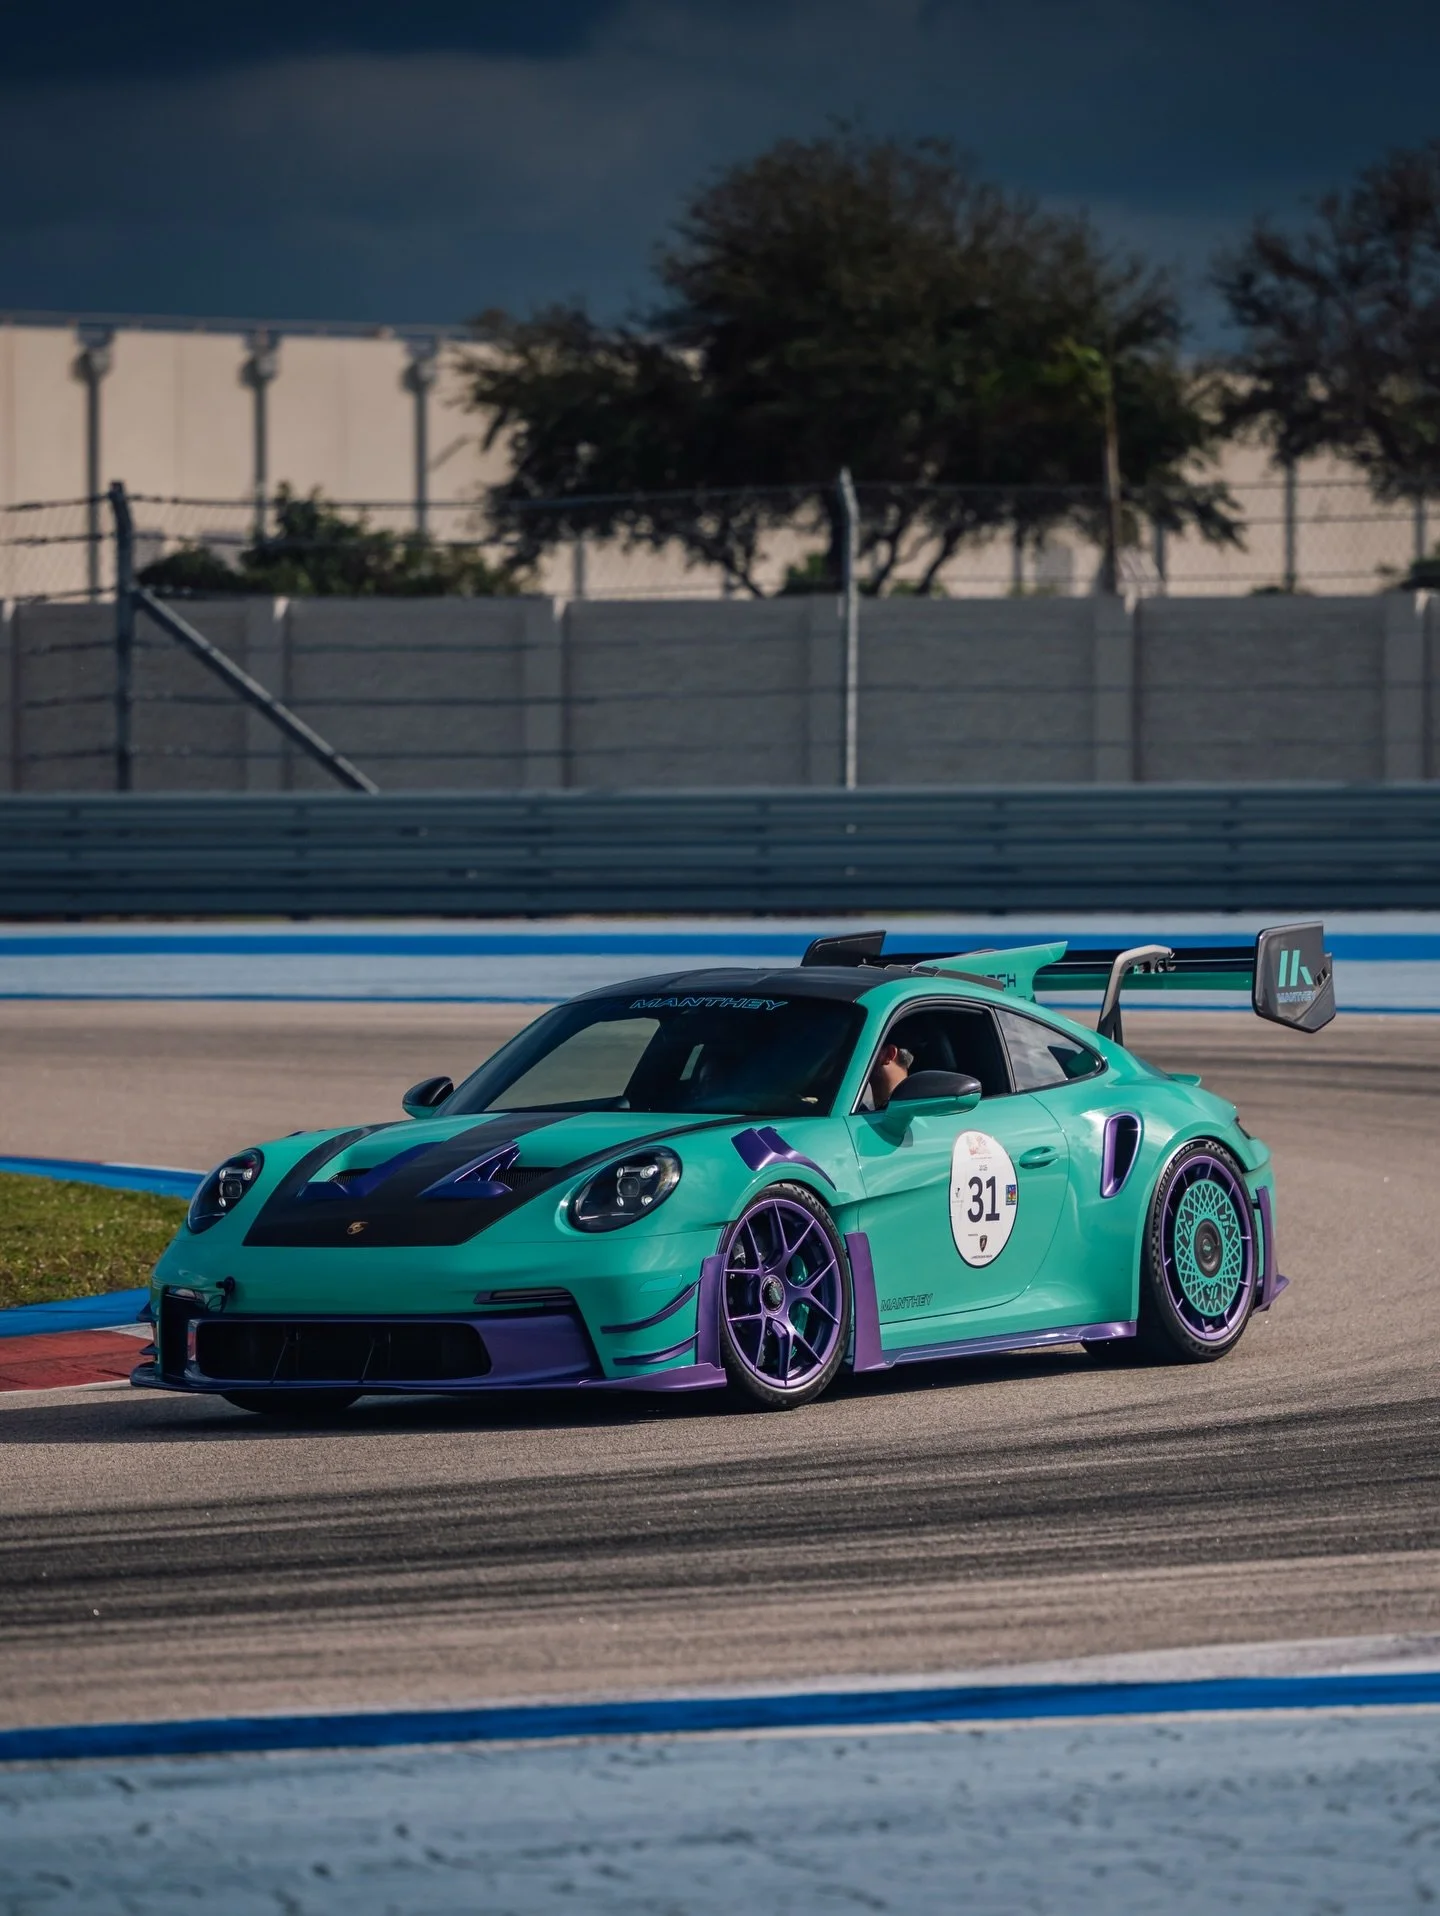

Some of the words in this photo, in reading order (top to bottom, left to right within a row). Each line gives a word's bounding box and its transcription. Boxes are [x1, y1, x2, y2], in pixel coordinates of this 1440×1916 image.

[629, 997, 788, 1010] MANTHEY
[967, 1175, 1000, 1223] 31
[880, 1292, 934, 1312] MANTHEY
